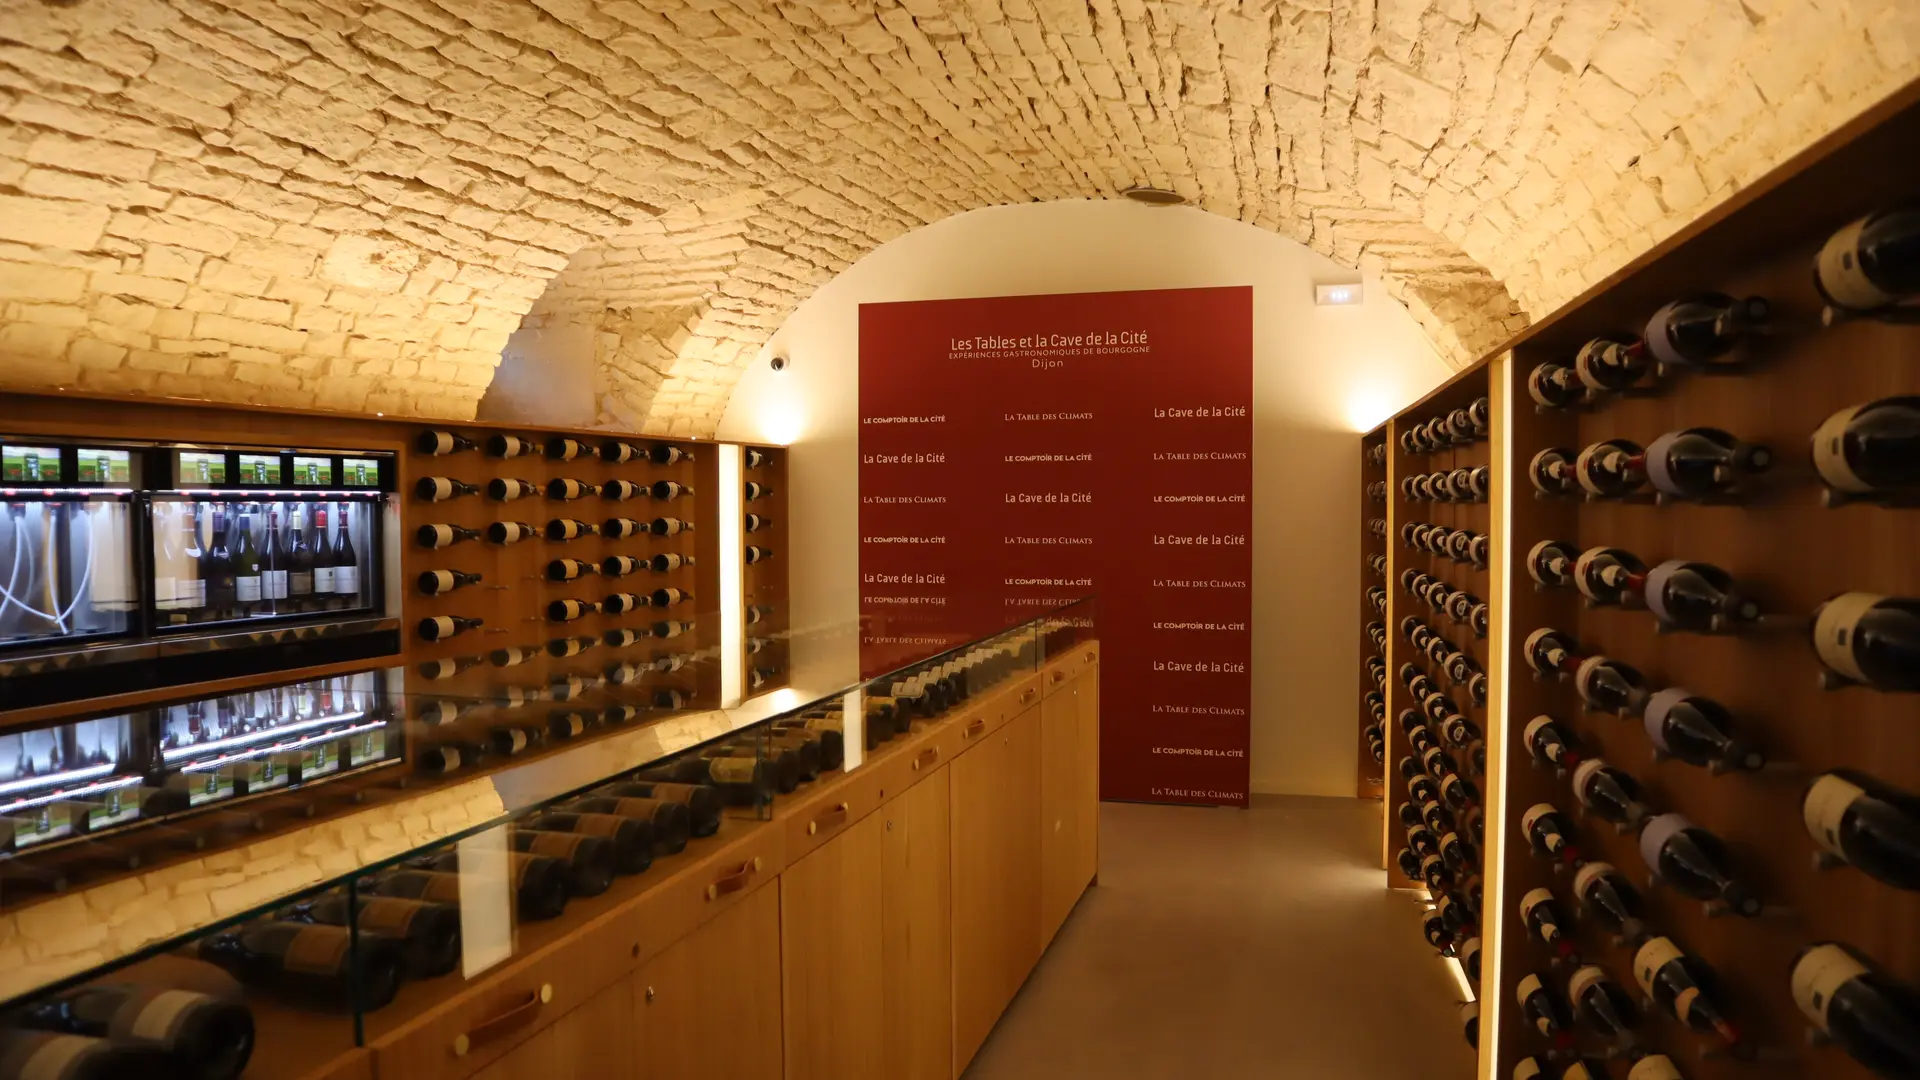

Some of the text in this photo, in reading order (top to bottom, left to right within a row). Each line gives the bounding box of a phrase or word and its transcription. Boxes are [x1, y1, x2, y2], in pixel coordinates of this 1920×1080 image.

[951, 329, 1148, 350] Les Tables et la Cave de la Cité
[948, 350, 1001, 359] EXPÉRIENCES
[1003, 348, 1081, 358] GASTRONOMIQUES
[1096, 346, 1151, 355] BOURGOGNE
[1031, 358, 1064, 370] Dijon
[1154, 405, 1246, 418] La Cave de la Cité
[863, 452, 946, 464] La Cave de la Cité
[1005, 492, 1092, 503] La Cave de la Cité
[1153, 534, 1246, 545] La Cave de la Cité
[864, 573, 946, 584] La Cave de la Cité
[1153, 660, 1245, 673] La Cave de la Cité
